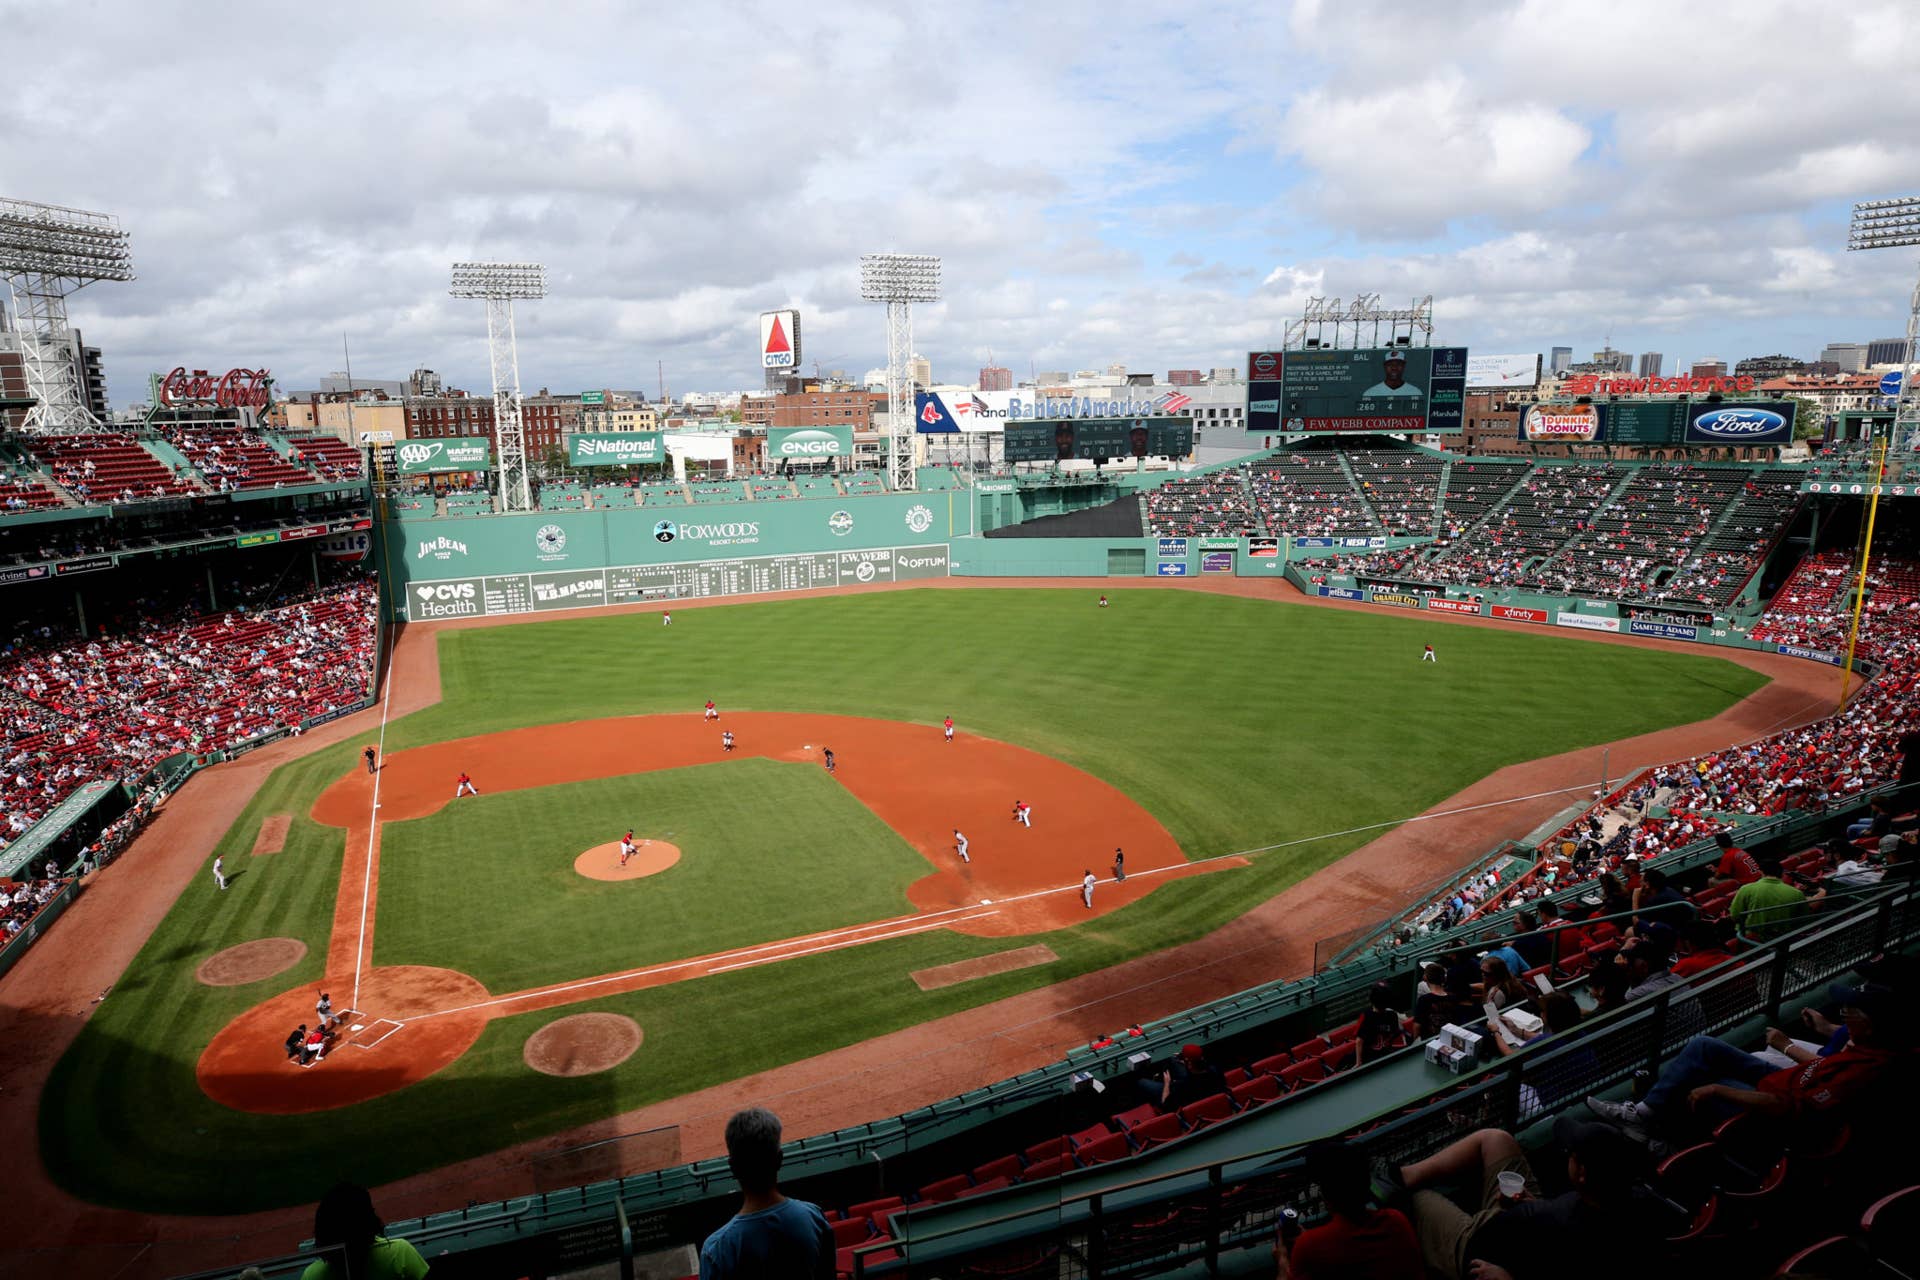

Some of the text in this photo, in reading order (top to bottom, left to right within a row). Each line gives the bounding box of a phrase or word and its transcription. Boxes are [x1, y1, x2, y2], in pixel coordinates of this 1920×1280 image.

[765, 353, 791, 366] CITGO
[1353, 353, 1369, 361] BAL
[160, 367, 270, 408] Coca-Cola
[1600, 371, 1754, 394] new balance
[1009, 397, 1058, 419] Bank
[1080, 397, 1153, 418] America
[1331, 418, 1363, 429] WEBB
[1365, 417, 1421, 429] COMPANY
[1546, 415, 1594, 424] DUNKIN'
[1711, 412, 1767, 432] Ford
[1546, 424, 1590, 433] DONUTS
[404, 444, 428, 461] AAA
[446, 447, 485, 455] MAPFRE
[680, 522, 760, 540] FOXWOODS
[418, 537, 468, 559] JIM BEAM
[1346, 539, 1367, 547] NESN
[860, 551, 891, 562] WEBB
[909, 557, 946, 568] OPTUM
[7, 571, 27, 580] vines
[435, 583, 476, 600] CVS
[1329, 587, 1353, 598] jetBlue
[1373, 594, 1403, 603] GRANITE
[1404, 596, 1418, 606] CITY
[1430, 600, 1480, 612] TRADER JOE'S
[420, 600, 478, 617] Health
[1504, 608, 1534, 620] xfinity
[1580, 618, 1603, 627] America
[1632, 622, 1665, 633] SAMUEL
[1666, 626, 1695, 637] ADAMS
[1710, 629, 1726, 637] 380
[1786, 647, 1834, 662] TOYO TIRES
